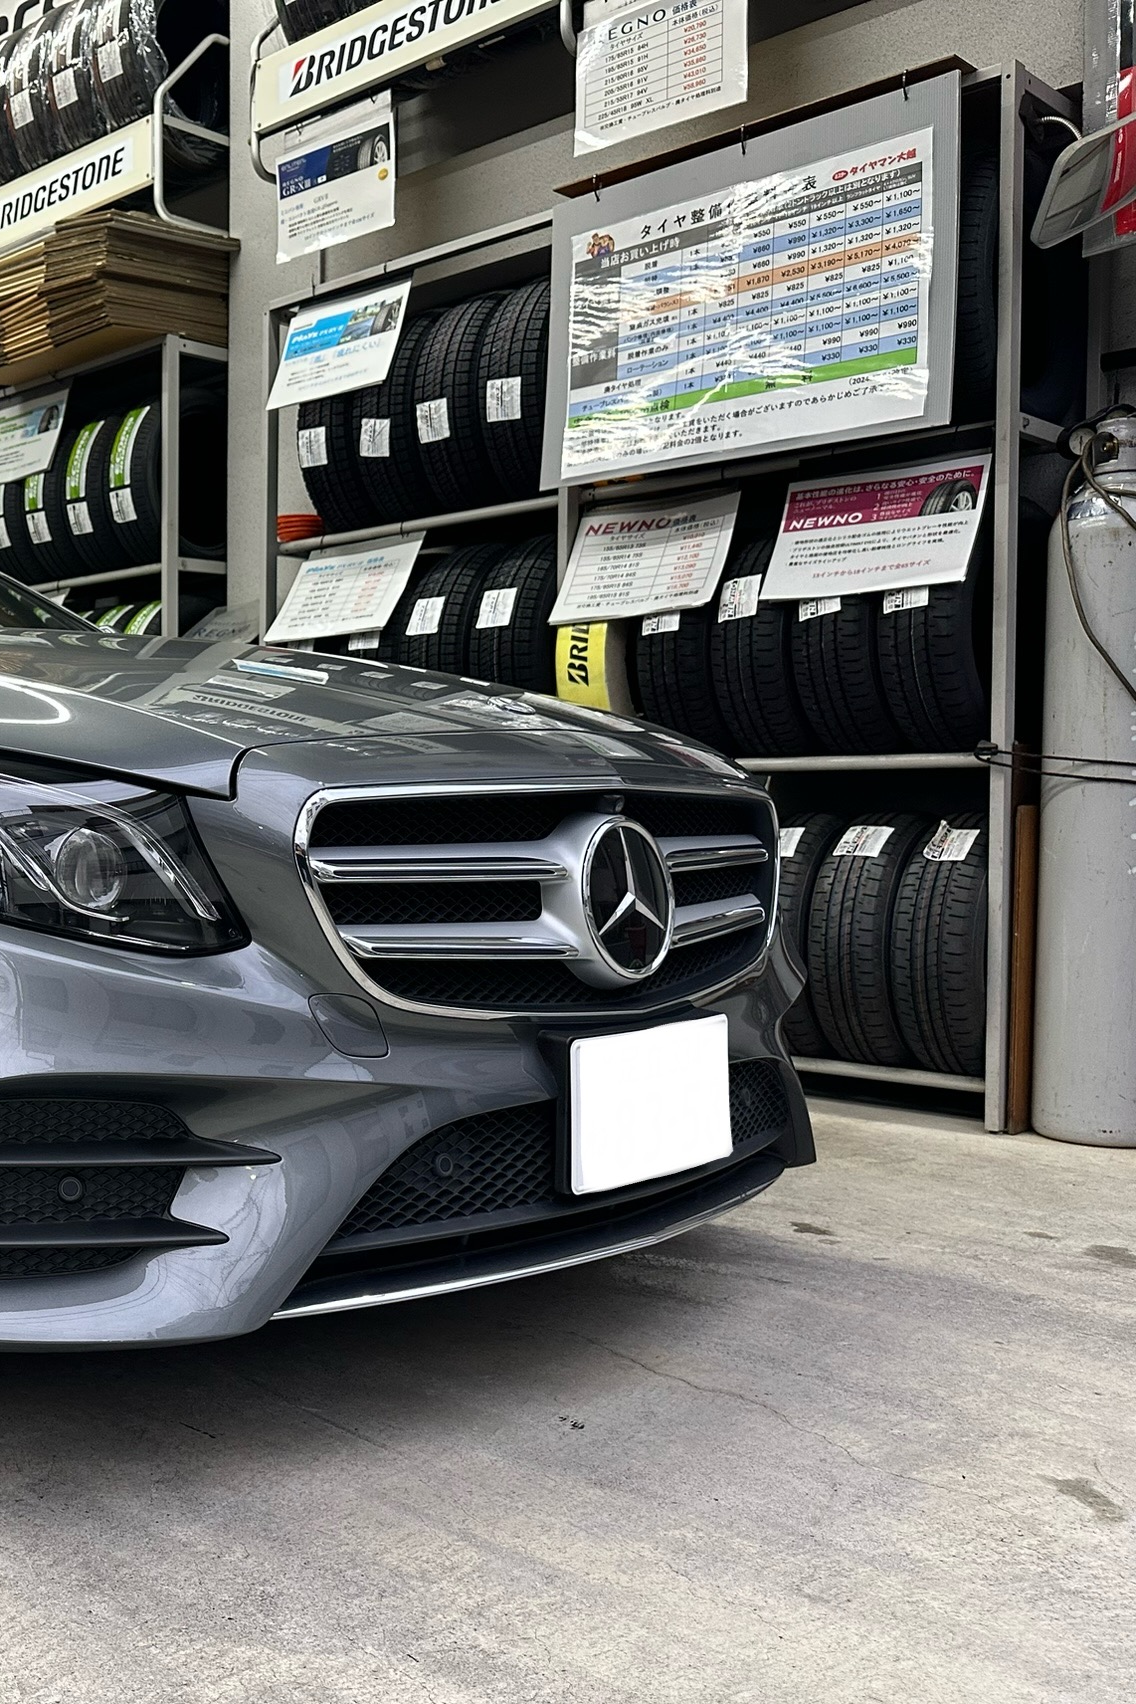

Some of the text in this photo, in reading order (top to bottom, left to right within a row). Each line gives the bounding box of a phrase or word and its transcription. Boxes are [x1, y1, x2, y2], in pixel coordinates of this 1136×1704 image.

[600, 9, 667, 42] EGNO
[289, 0, 502, 97] BRIDGESTO
[789, 219, 807, 229] ¥550
[786, 282, 805, 292] ¥825
[897, 319, 917, 330] ¥990
[897, 335, 917, 346] ¥330
[858, 343, 878, 354] ¥330
[627, 360, 669, 374] ローテーション
[585, 517, 671, 536] NEWNO
[789, 512, 863, 530] NEWNO
